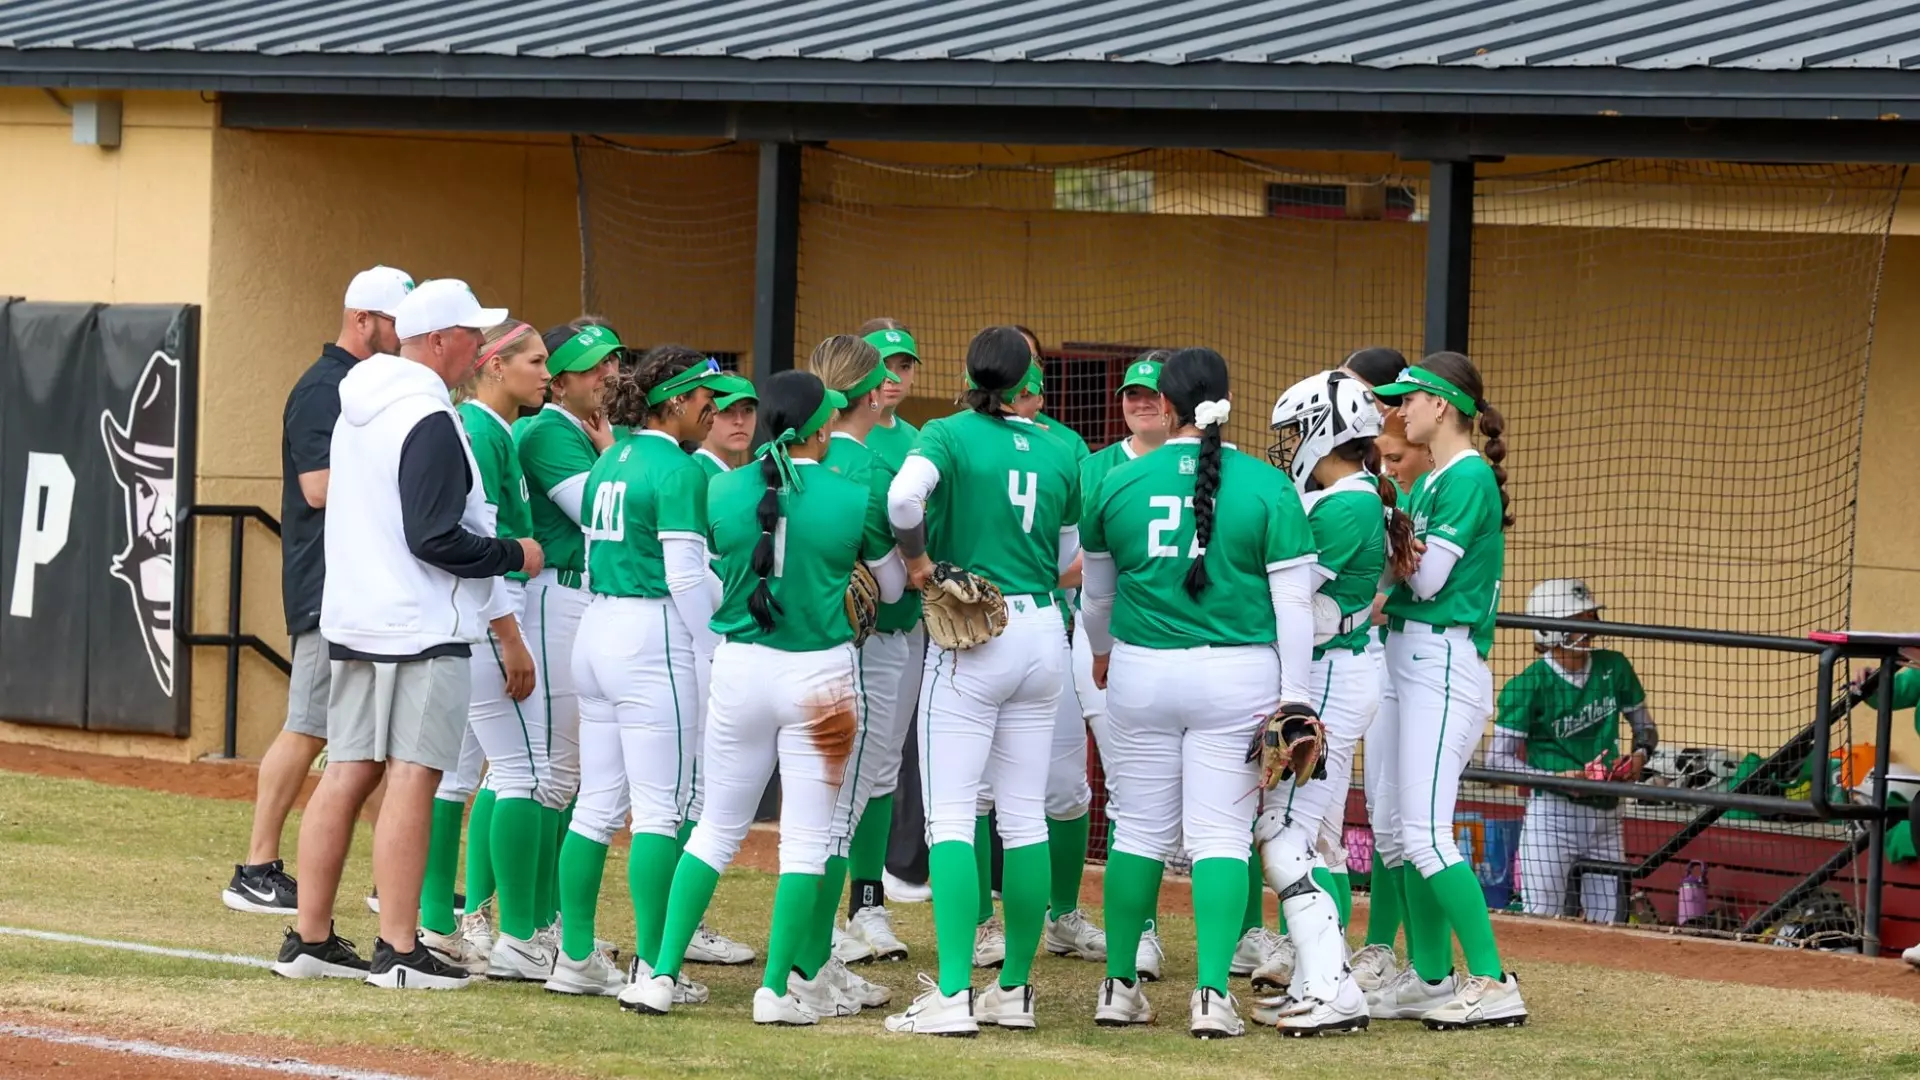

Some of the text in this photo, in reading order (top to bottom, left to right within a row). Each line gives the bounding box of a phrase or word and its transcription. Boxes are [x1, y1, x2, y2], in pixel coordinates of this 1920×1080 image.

[590, 481, 627, 542] 00
[1008, 469, 1038, 534] 4
[10, 451, 76, 618] P
